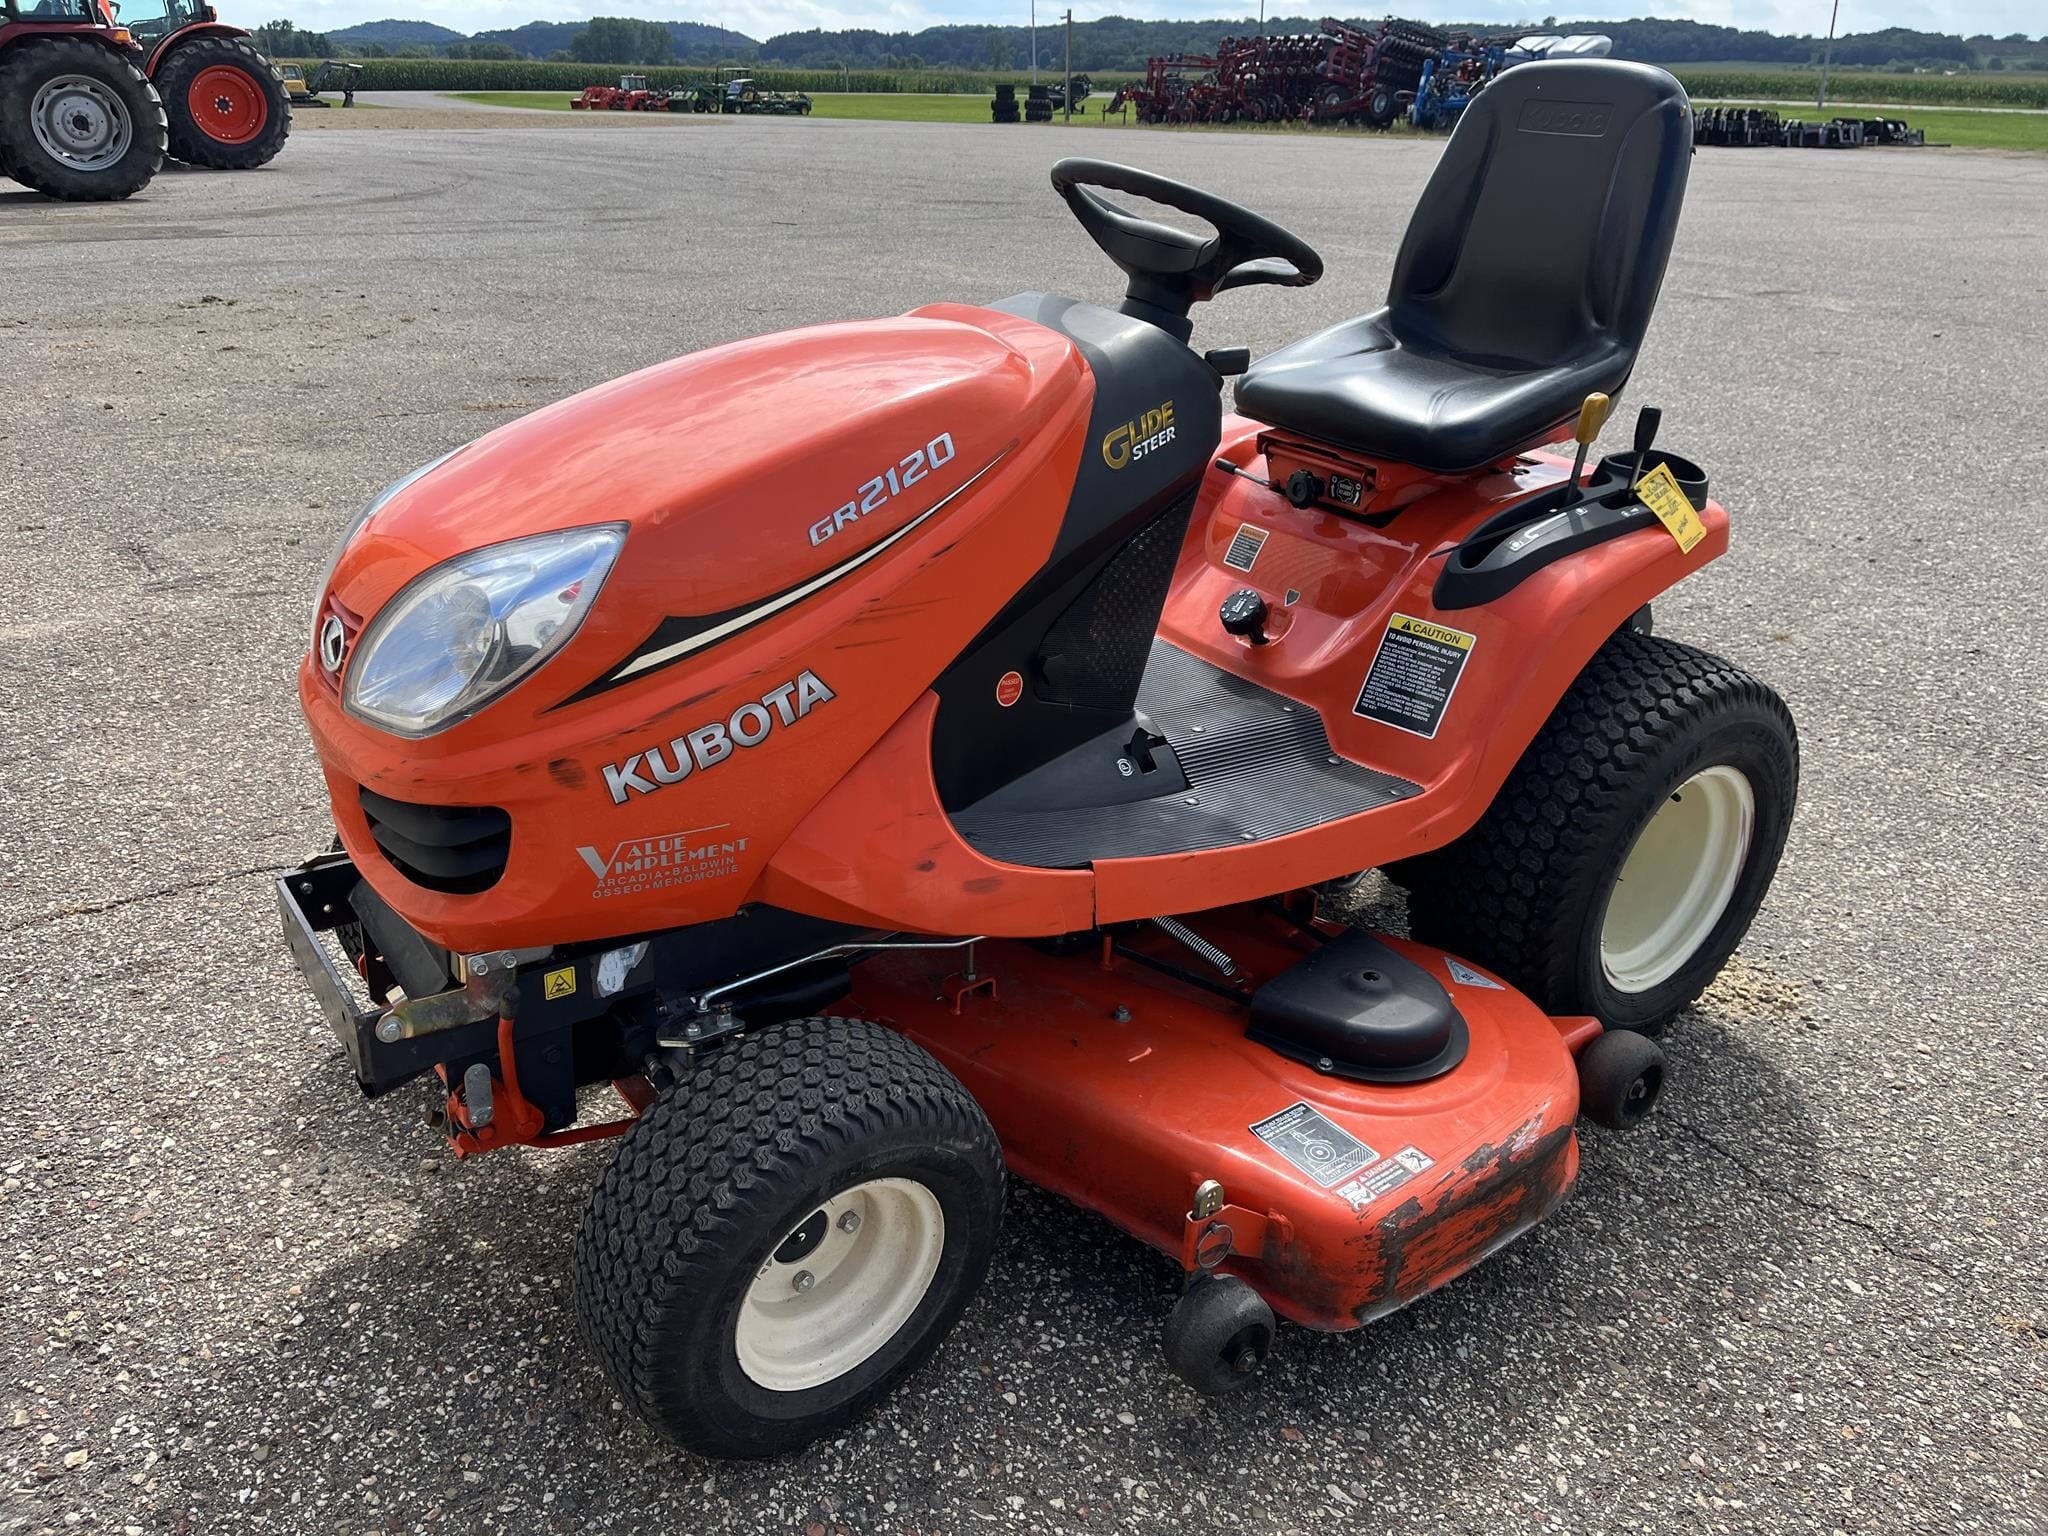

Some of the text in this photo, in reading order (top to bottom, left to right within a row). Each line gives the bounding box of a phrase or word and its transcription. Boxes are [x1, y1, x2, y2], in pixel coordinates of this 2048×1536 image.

[1103, 400, 1175, 470] GLIDE
[1133, 427, 1176, 461] STEER
[809, 432, 955, 547] GR2120
[1395, 634, 1412, 644] AVOID
[1411, 639, 1441, 652] PERSONAL
[1440, 647, 1461, 659] INJURY
[1412, 623, 1460, 644] CAUTION
[602, 669, 837, 805] KUBOTA
[576, 836, 687, 879] VALUE
[616, 838, 749, 875] IMPLEMENT
[1365, 1158, 1394, 1178] DANGER
